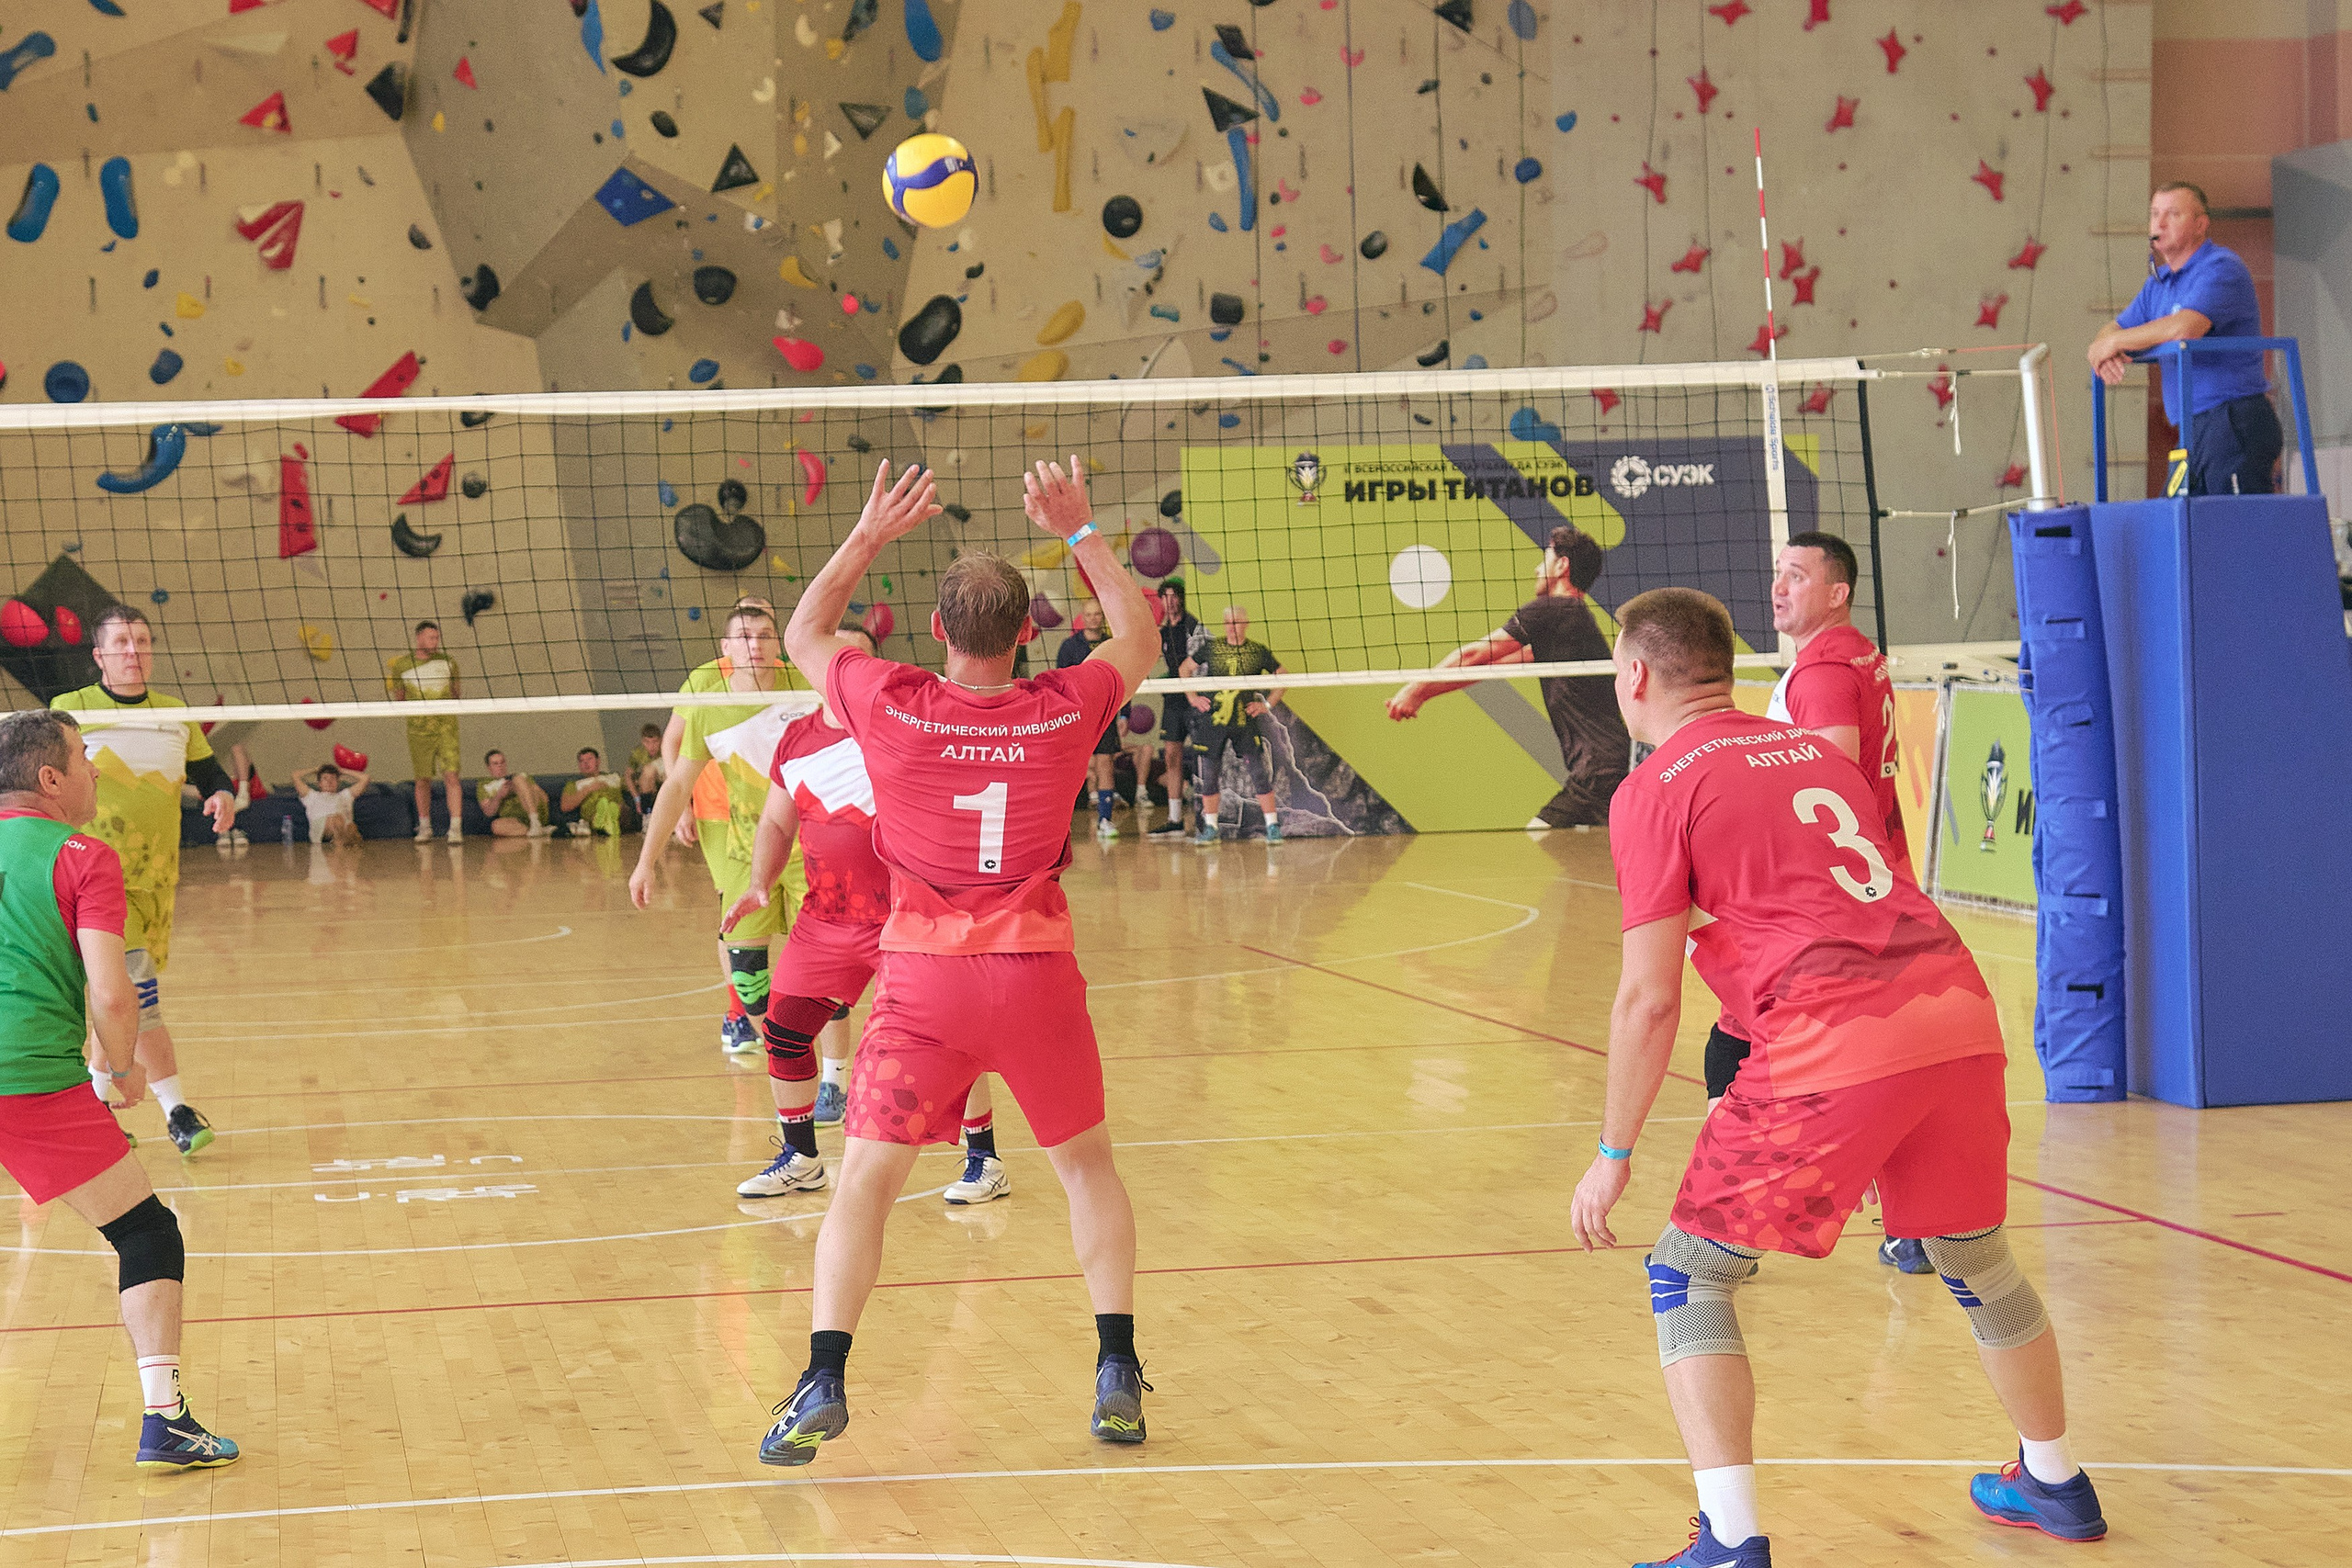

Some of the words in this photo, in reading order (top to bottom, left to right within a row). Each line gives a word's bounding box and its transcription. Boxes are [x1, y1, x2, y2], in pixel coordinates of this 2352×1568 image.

[1344, 478, 1437, 502] ИГРЫ
[1443, 475, 1596, 501] ТИТАНОВ
[1654, 463, 1715, 488] СУЭК
[885, 705, 1009, 738] ЭНЕРГЕТИЧЕСКИЙ
[1011, 710, 1082, 738] ДИВИЗИОН
[940, 742, 1026, 762] АЛТАЙ
[1658, 729, 1787, 784] ЭНЕРГЕТИЧЕСКИЙ
[1745, 742, 1824, 769] АЛТАЙ
[953, 781, 1009, 874] 1
[1792, 787, 1894, 904] 3
